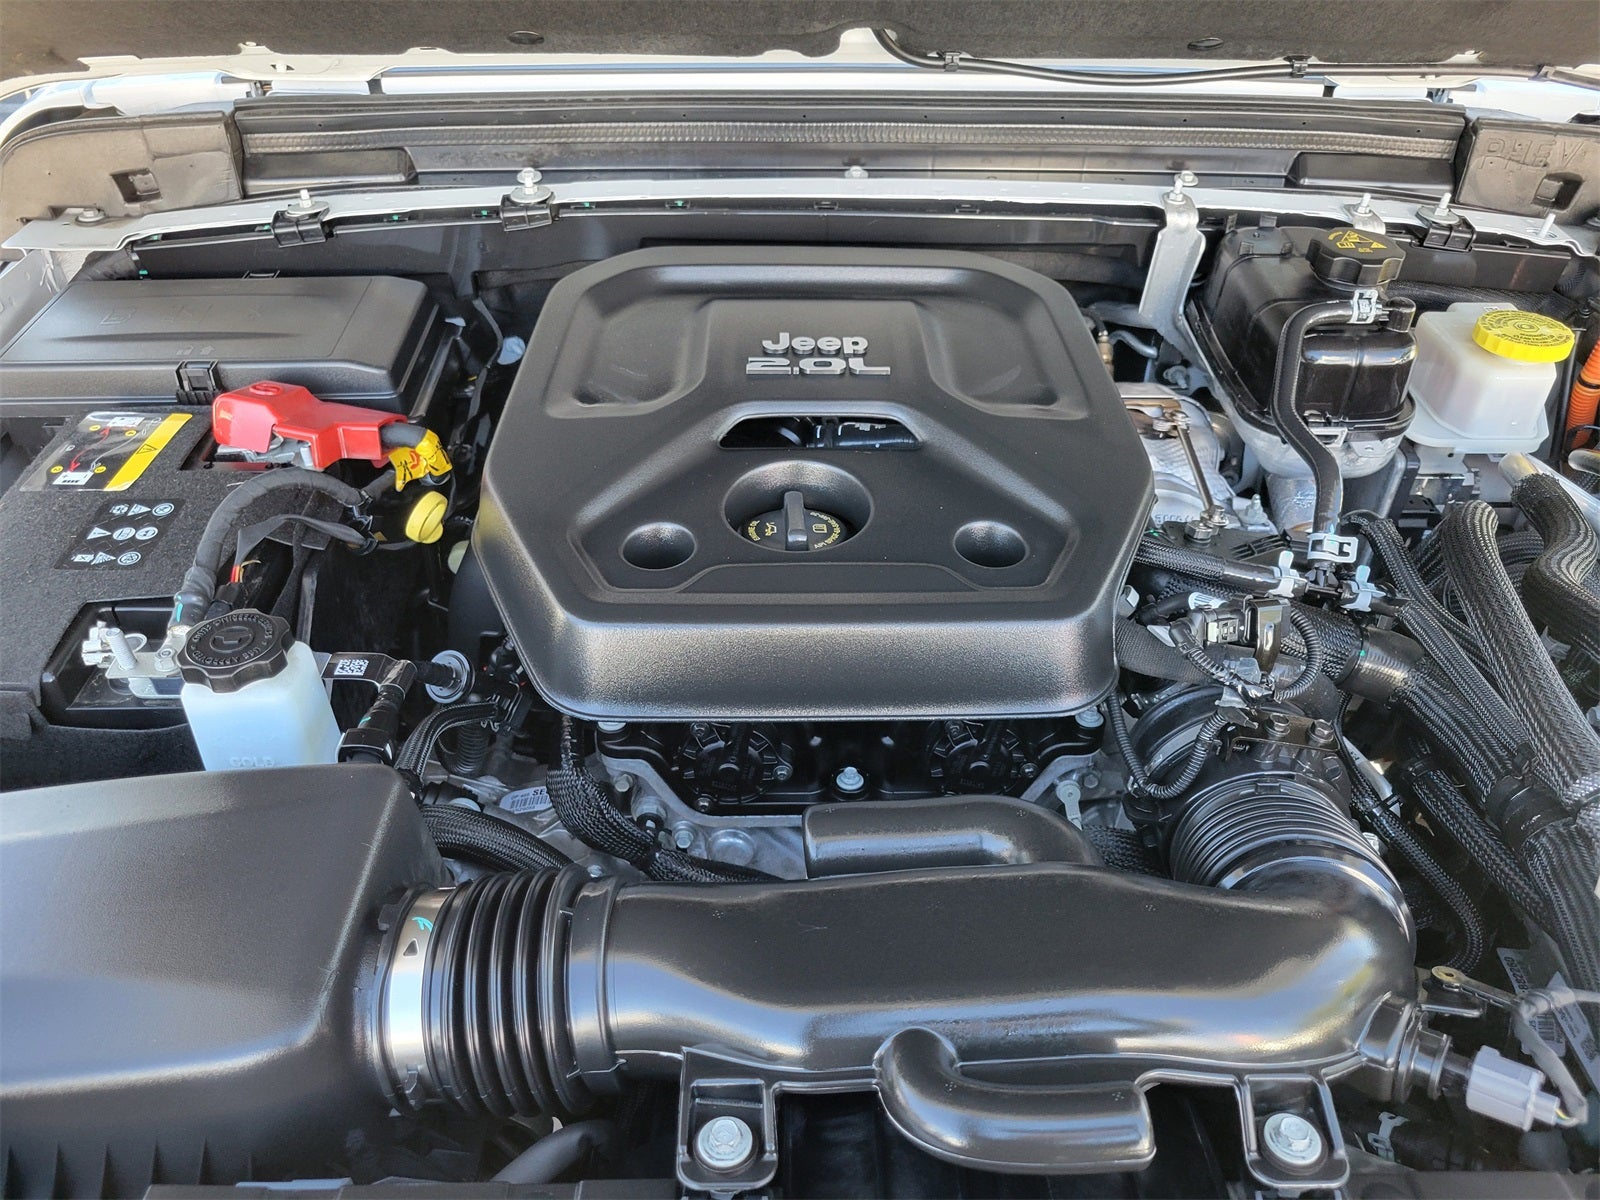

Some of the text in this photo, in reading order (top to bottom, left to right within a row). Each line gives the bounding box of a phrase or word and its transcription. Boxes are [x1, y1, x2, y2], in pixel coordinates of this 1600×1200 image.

[1479, 138, 1585, 169] PHEV
[762, 332, 869, 355] Jeep
[746, 356, 891, 375] 2.0L
[212, 613, 260, 628] STEERING
